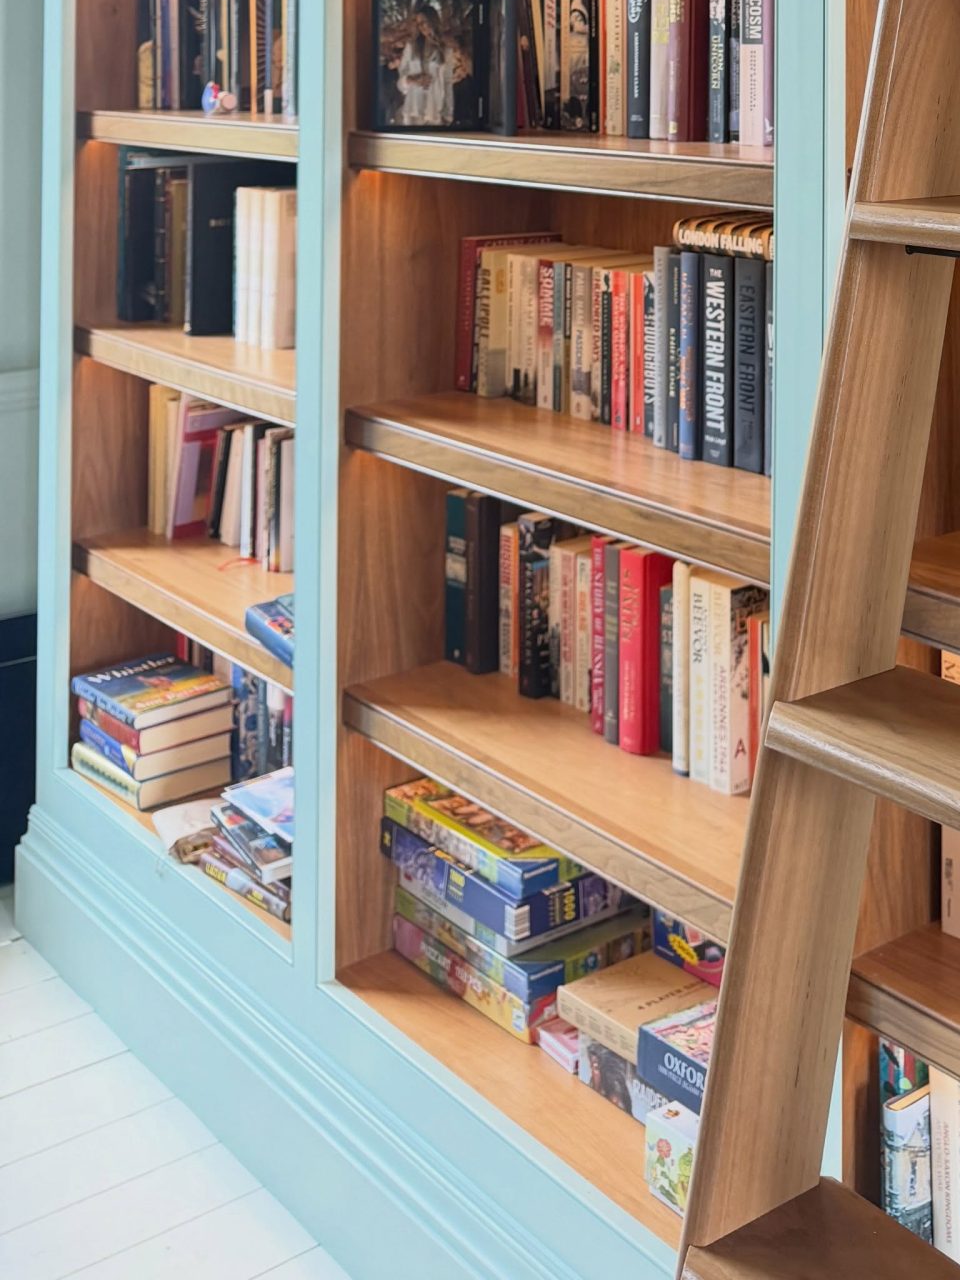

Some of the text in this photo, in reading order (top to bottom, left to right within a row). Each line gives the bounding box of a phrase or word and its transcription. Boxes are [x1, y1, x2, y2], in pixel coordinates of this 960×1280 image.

[710, 34, 721, 89] UNICORN
[679, 228, 764, 255] LONDON FALLING
[540, 266, 555, 327] SOMME
[705, 281, 726, 432] WESTERN FRONT
[738, 284, 757, 416] EASTERN FRONT
[692, 591, 703, 664] BEEVOR
